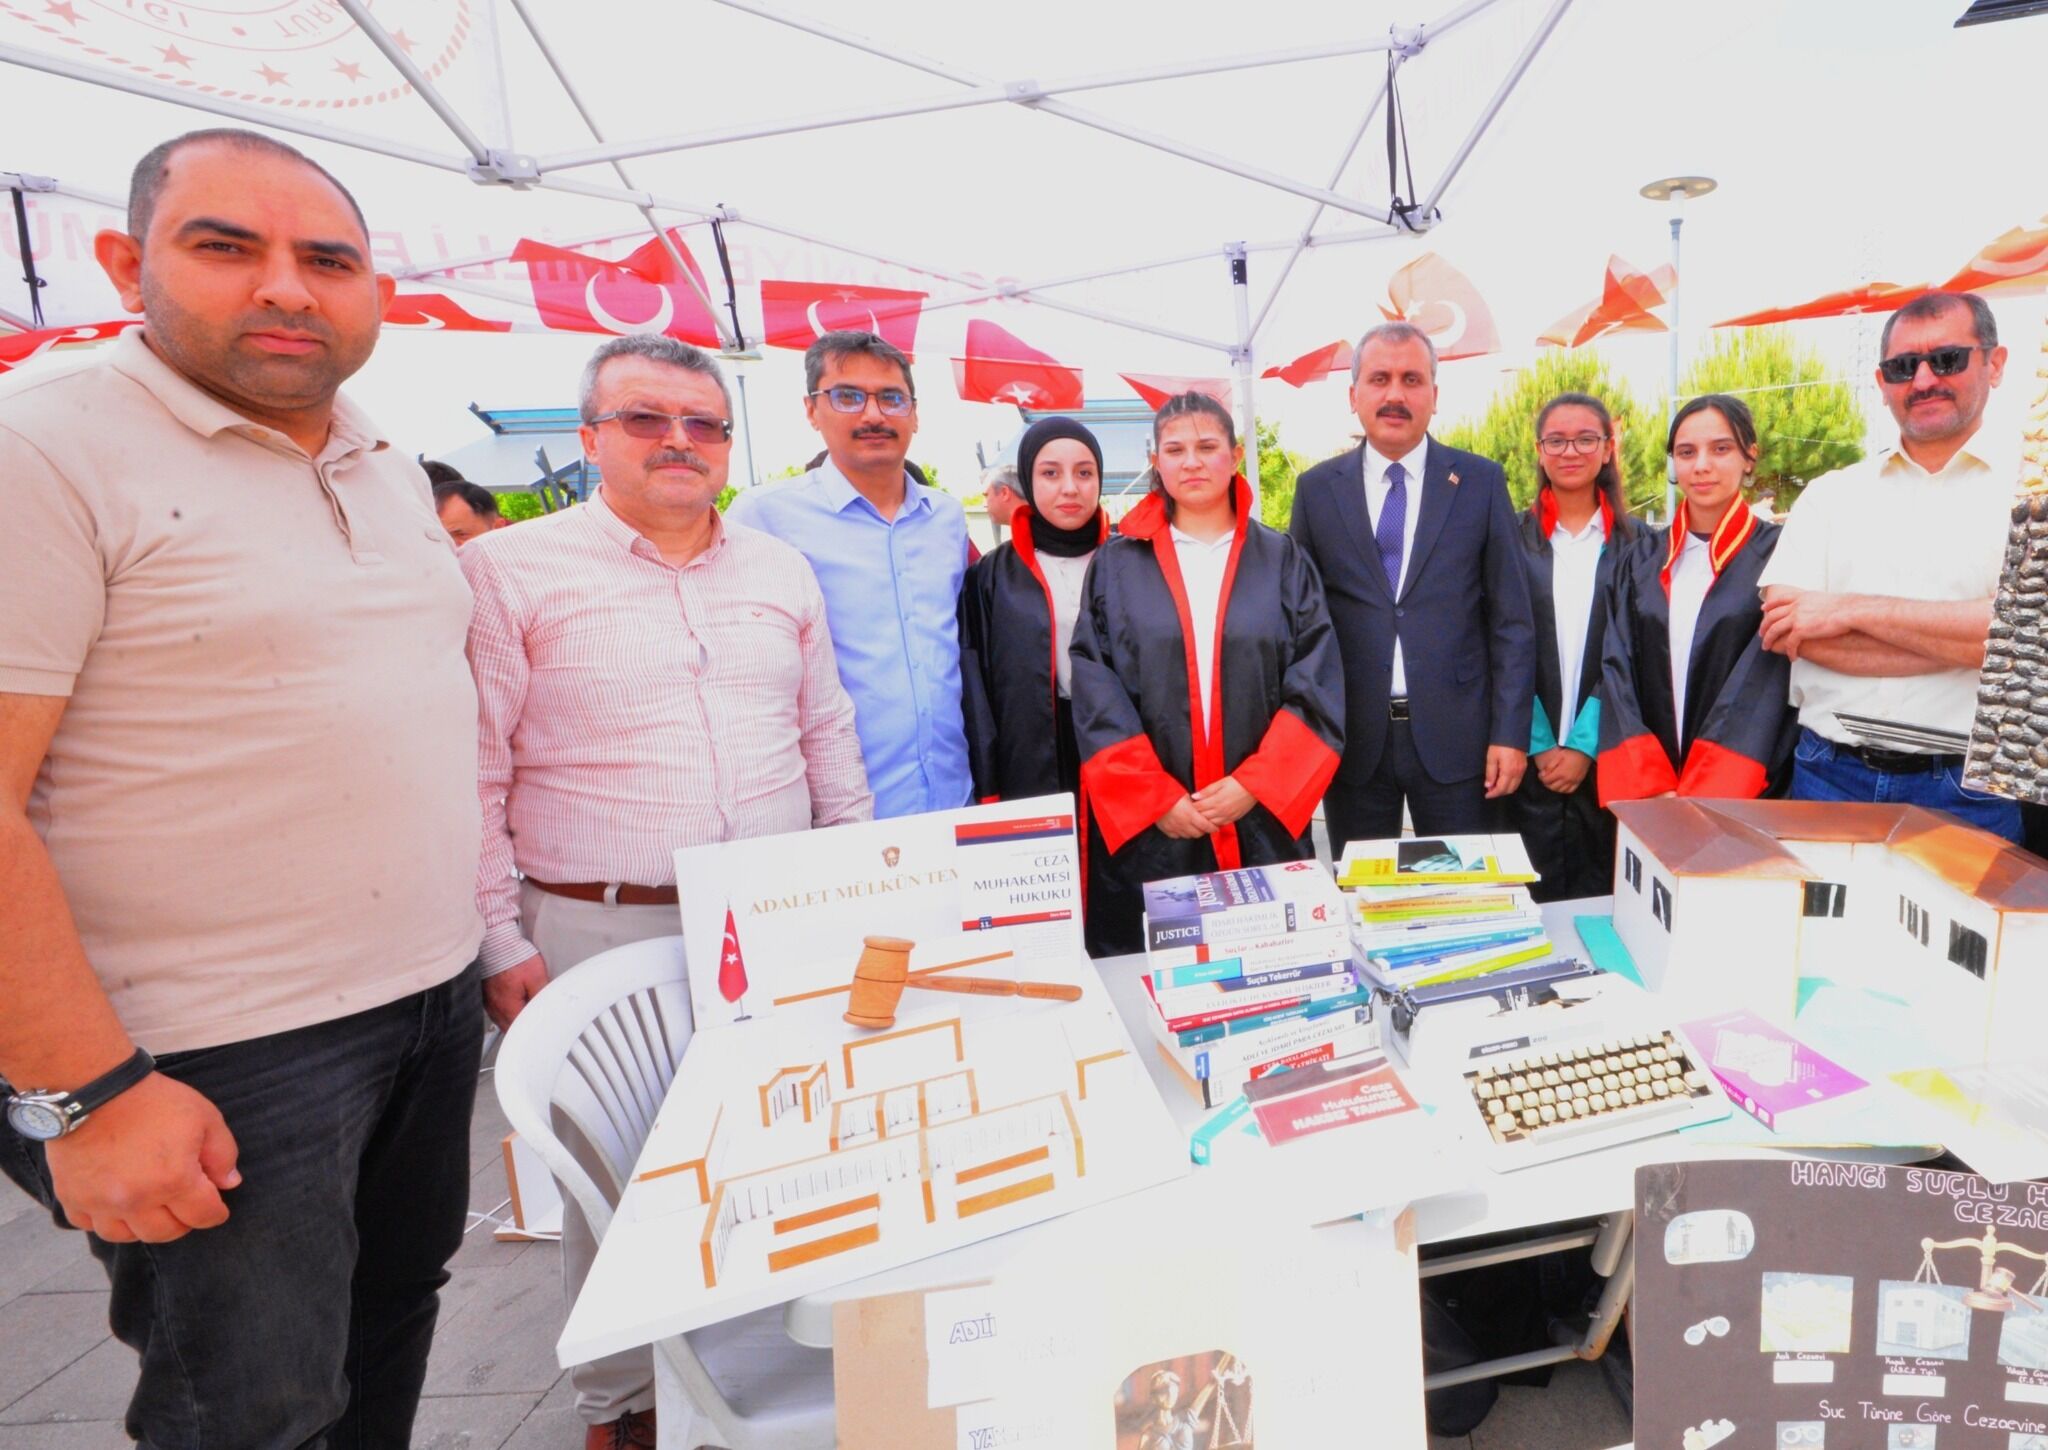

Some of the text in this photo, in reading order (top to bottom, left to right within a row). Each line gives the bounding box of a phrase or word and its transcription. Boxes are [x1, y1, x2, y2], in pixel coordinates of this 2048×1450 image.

[1034, 853, 1070, 869] CEZA
[973, 870, 1070, 891] MUHAKEMESİ
[749, 889, 831, 916] ADALET
[836, 873, 920, 900] MÜLKÜN
[1009, 888, 1070, 905] HUKUKU
[1155, 925, 1200, 944] JUSTICE
[1246, 968, 1302, 986] Suçta Tekerrür
[1791, 1161, 1886, 1189] HANGİ
[1916, 1402, 1951, 1424] Göre
[1964, 1404, 2047, 1434] Cezaevine
